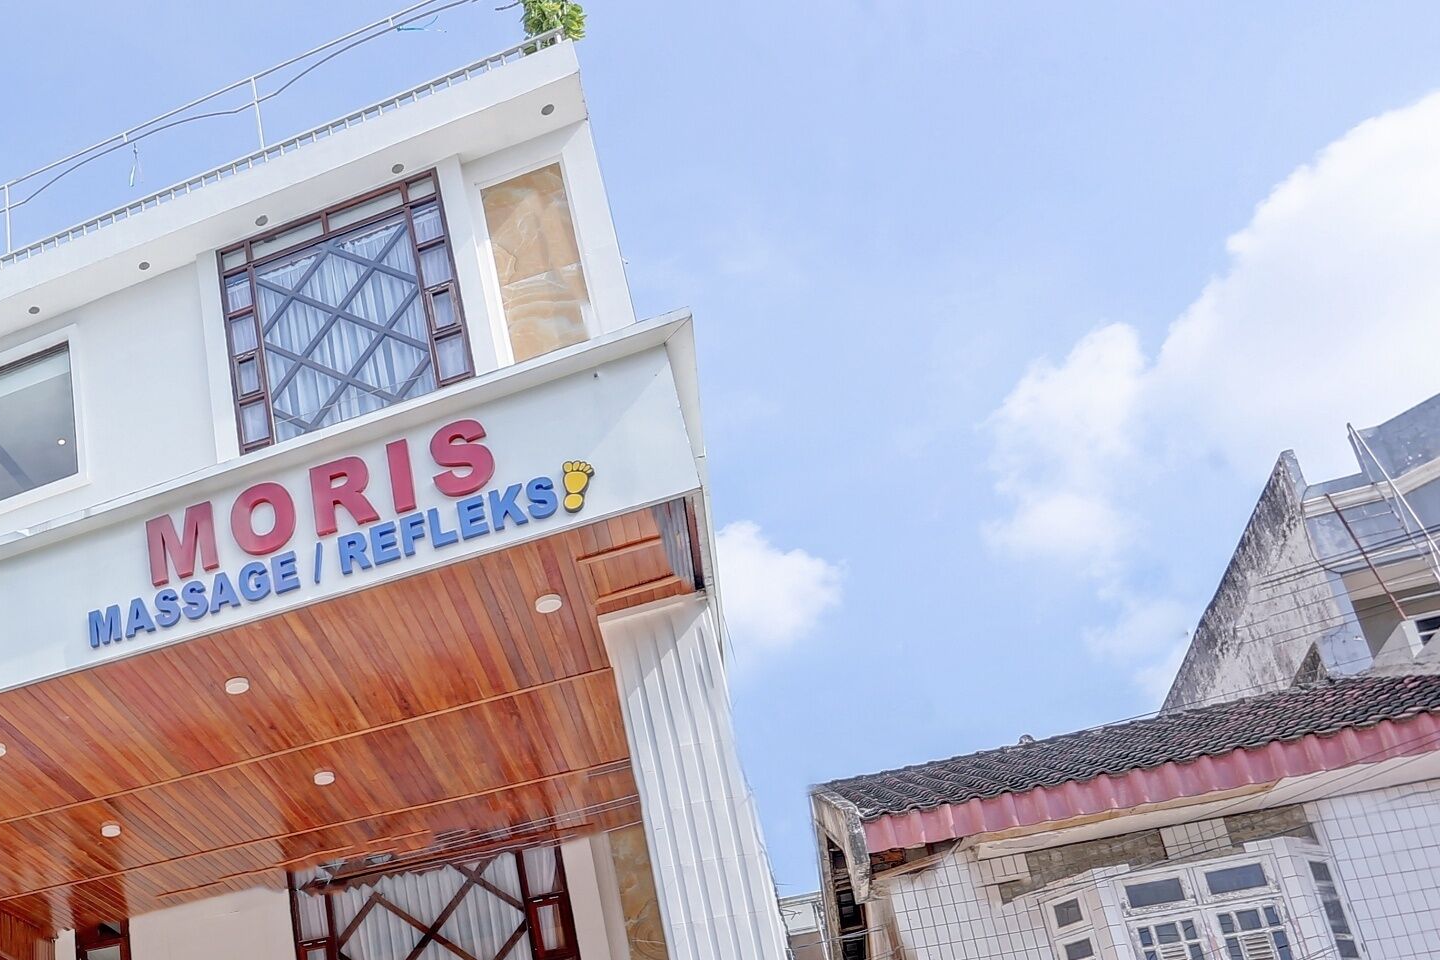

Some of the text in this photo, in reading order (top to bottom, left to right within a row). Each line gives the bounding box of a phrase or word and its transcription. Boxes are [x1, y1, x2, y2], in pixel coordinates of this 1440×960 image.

[87, 476, 558, 648] MASSAGE / REFLEKS
[146, 418, 495, 587] MORIS
